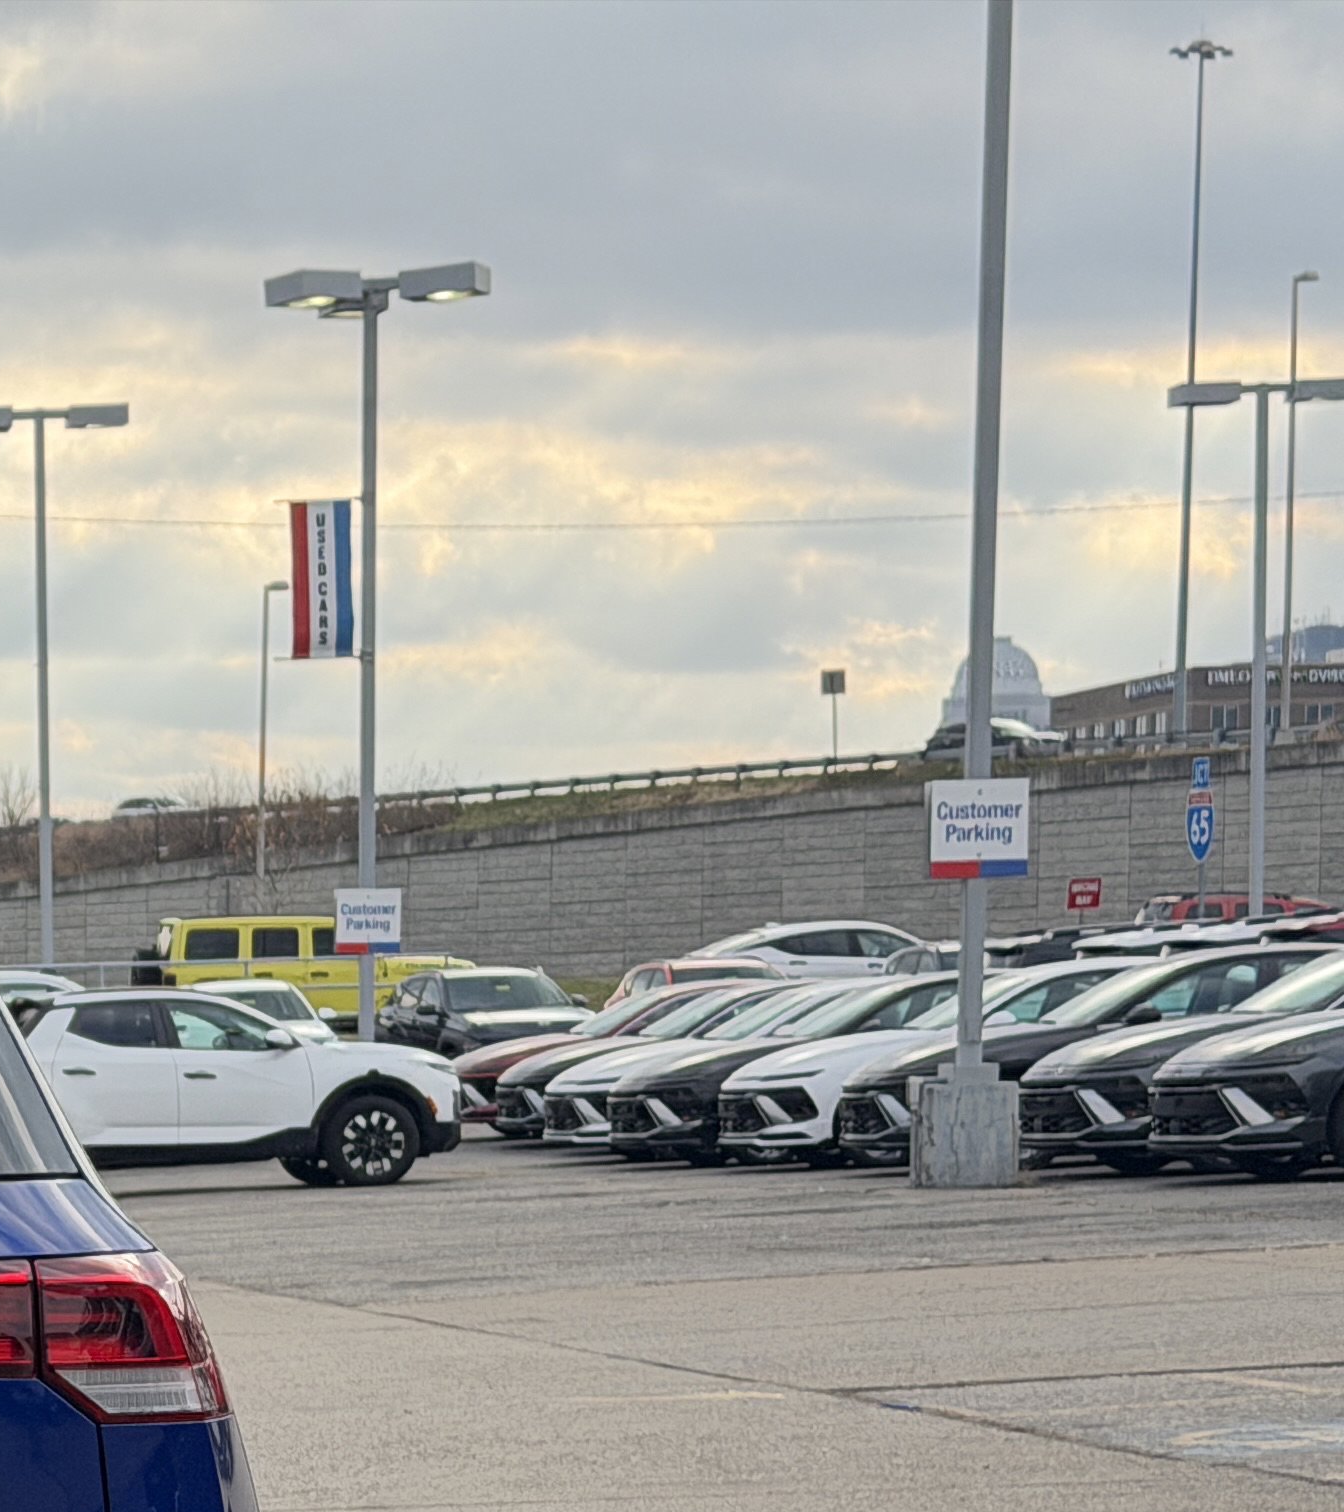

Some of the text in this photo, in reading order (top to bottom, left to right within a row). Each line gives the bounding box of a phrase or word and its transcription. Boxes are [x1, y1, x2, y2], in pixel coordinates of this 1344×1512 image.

[315, 512, 328, 645] USED CARS
[937, 801, 1023, 820] Customer
[945, 823, 1013, 845] Parking
[1191, 810, 1210, 845] 65
[341, 904, 396, 915] Customer
[346, 917, 390, 933] Parking
